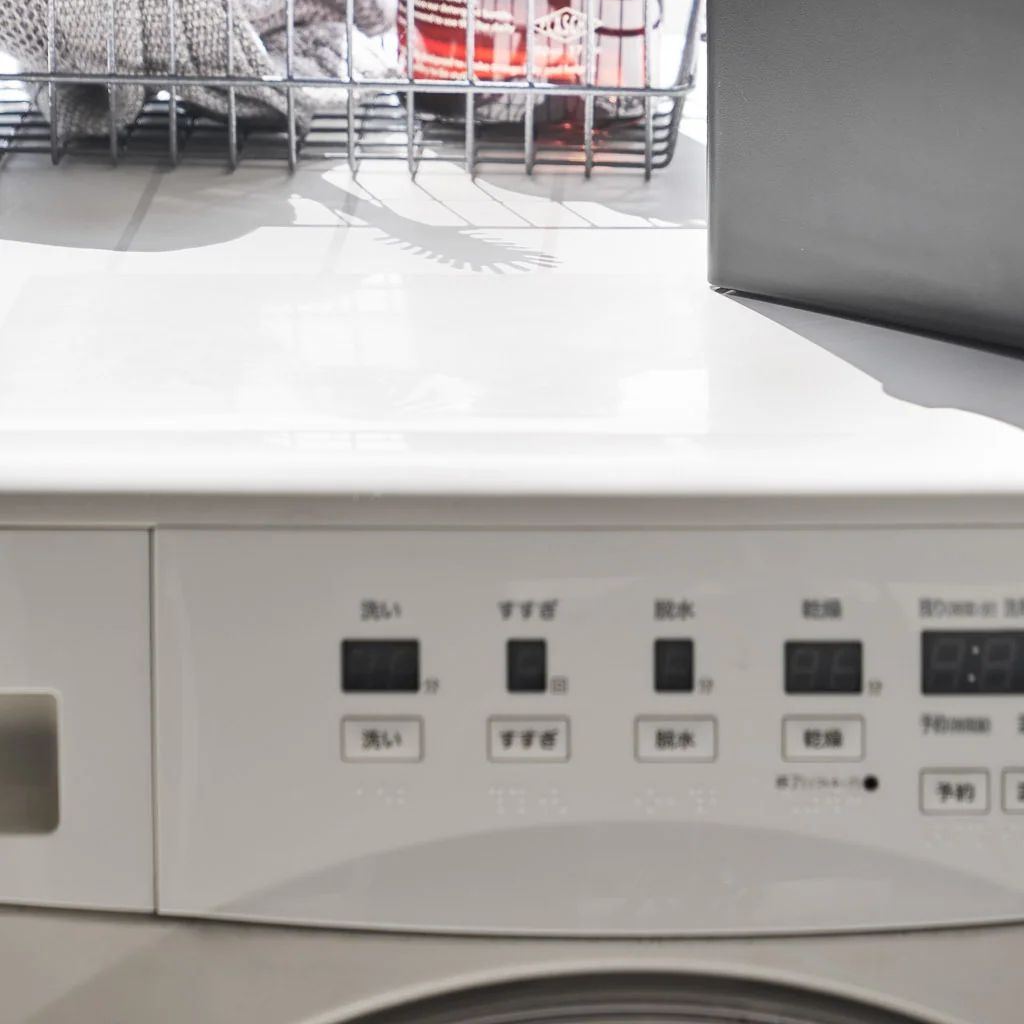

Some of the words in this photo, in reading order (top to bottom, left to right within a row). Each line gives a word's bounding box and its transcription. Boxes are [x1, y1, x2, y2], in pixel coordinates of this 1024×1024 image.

[361, 599, 402, 621] 洗い
[498, 599, 559, 621] すすぎ
[653, 599, 695, 621] 脱水
[801, 598, 842, 620] 乾燥
[361, 728, 403, 750] 洗い
[499, 728, 559, 750] すすぎ
[654, 728, 696, 750] 脱水
[802, 728, 843, 749] 乾燥
[936, 781, 976, 803] 予約
